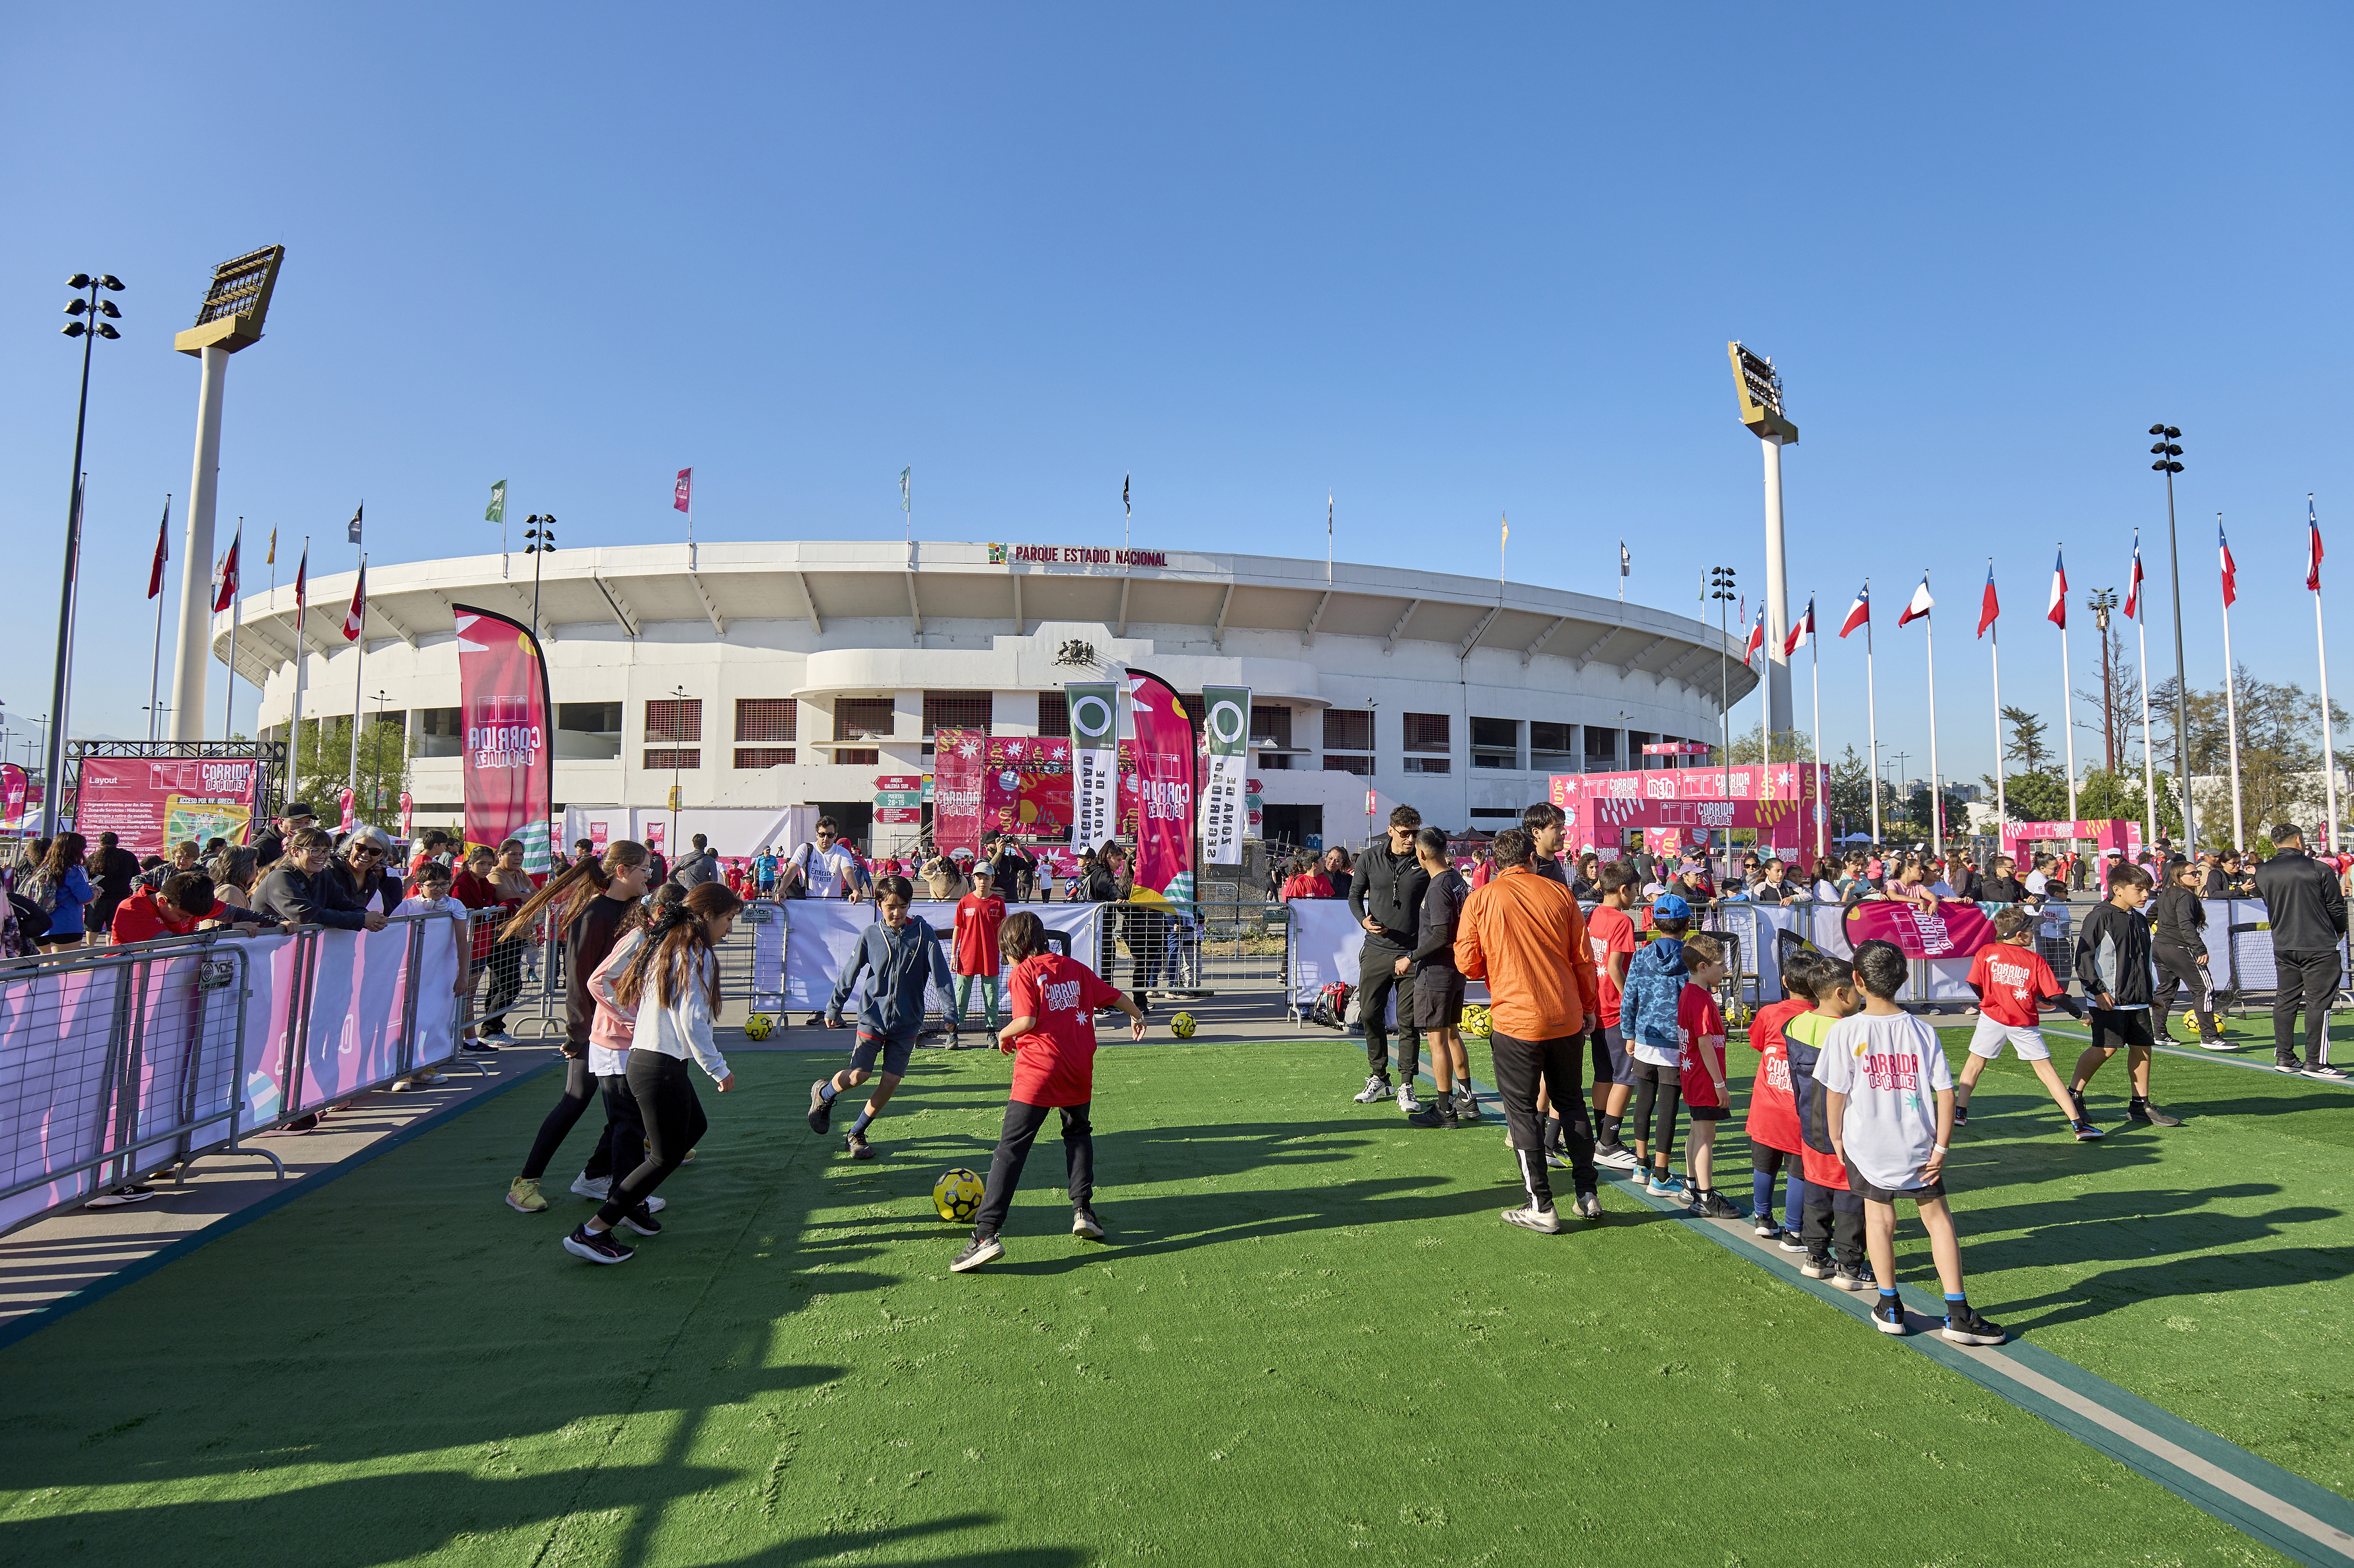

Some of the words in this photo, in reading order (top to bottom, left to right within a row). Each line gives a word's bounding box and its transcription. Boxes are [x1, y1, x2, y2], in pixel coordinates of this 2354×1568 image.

[1016, 546, 1059, 561] PARQUE
[1064, 548, 1110, 563] ESTADIO
[1116, 550, 1168, 567] NACIONAL
[202, 763, 251, 780] CORRIDA
[89, 777, 118, 785] Layout
[206, 779, 217, 791] DE
[216, 779, 225, 793] LA
[1609, 777, 1638, 791] CORRIDA
[1648, 777, 1675, 799] META
[936, 791, 980, 806] CORRIDA
[1612, 789, 1619, 798] DE
[940, 804, 949, 816] DE
[949, 805, 958, 816] LA
[1698, 801, 1735, 816] CORRIDA
[1701, 815, 1709, 826] DE
[1709, 814, 1716, 826] LA
[1715, 814, 1732, 826] NIÑEZ
[2053, 822, 2074, 832] CORRIDA
[1596, 847, 1619, 857] CORRIDA
[1777, 847, 1798, 857] CORRIDA
[810, 867, 835, 877] Emirates
[1907, 902, 1943, 955] CORRIDA
[215, 962, 233, 974] VDS
[1991, 962, 2030, 980] CORRIDA
[1993, 973, 2002, 982] DE
[2001, 975, 2008, 984] LA
[2008, 977, 2025, 988] NIÑEZ
[1045, 980, 1080, 999] CORRIDA
[1049, 998, 1059, 1011] DE
[1057, 998, 1067, 1011] LA
[1863, 1053, 1918, 1074] CORRIDA
[1768, 1072, 1780, 1085] DE
[1779, 1076, 1788, 1090] LA
[1869, 1072, 1882, 1089] DE
[1881, 1073, 1893, 1091] LA
[1893, 1072, 1917, 1091] NIÑEZ
